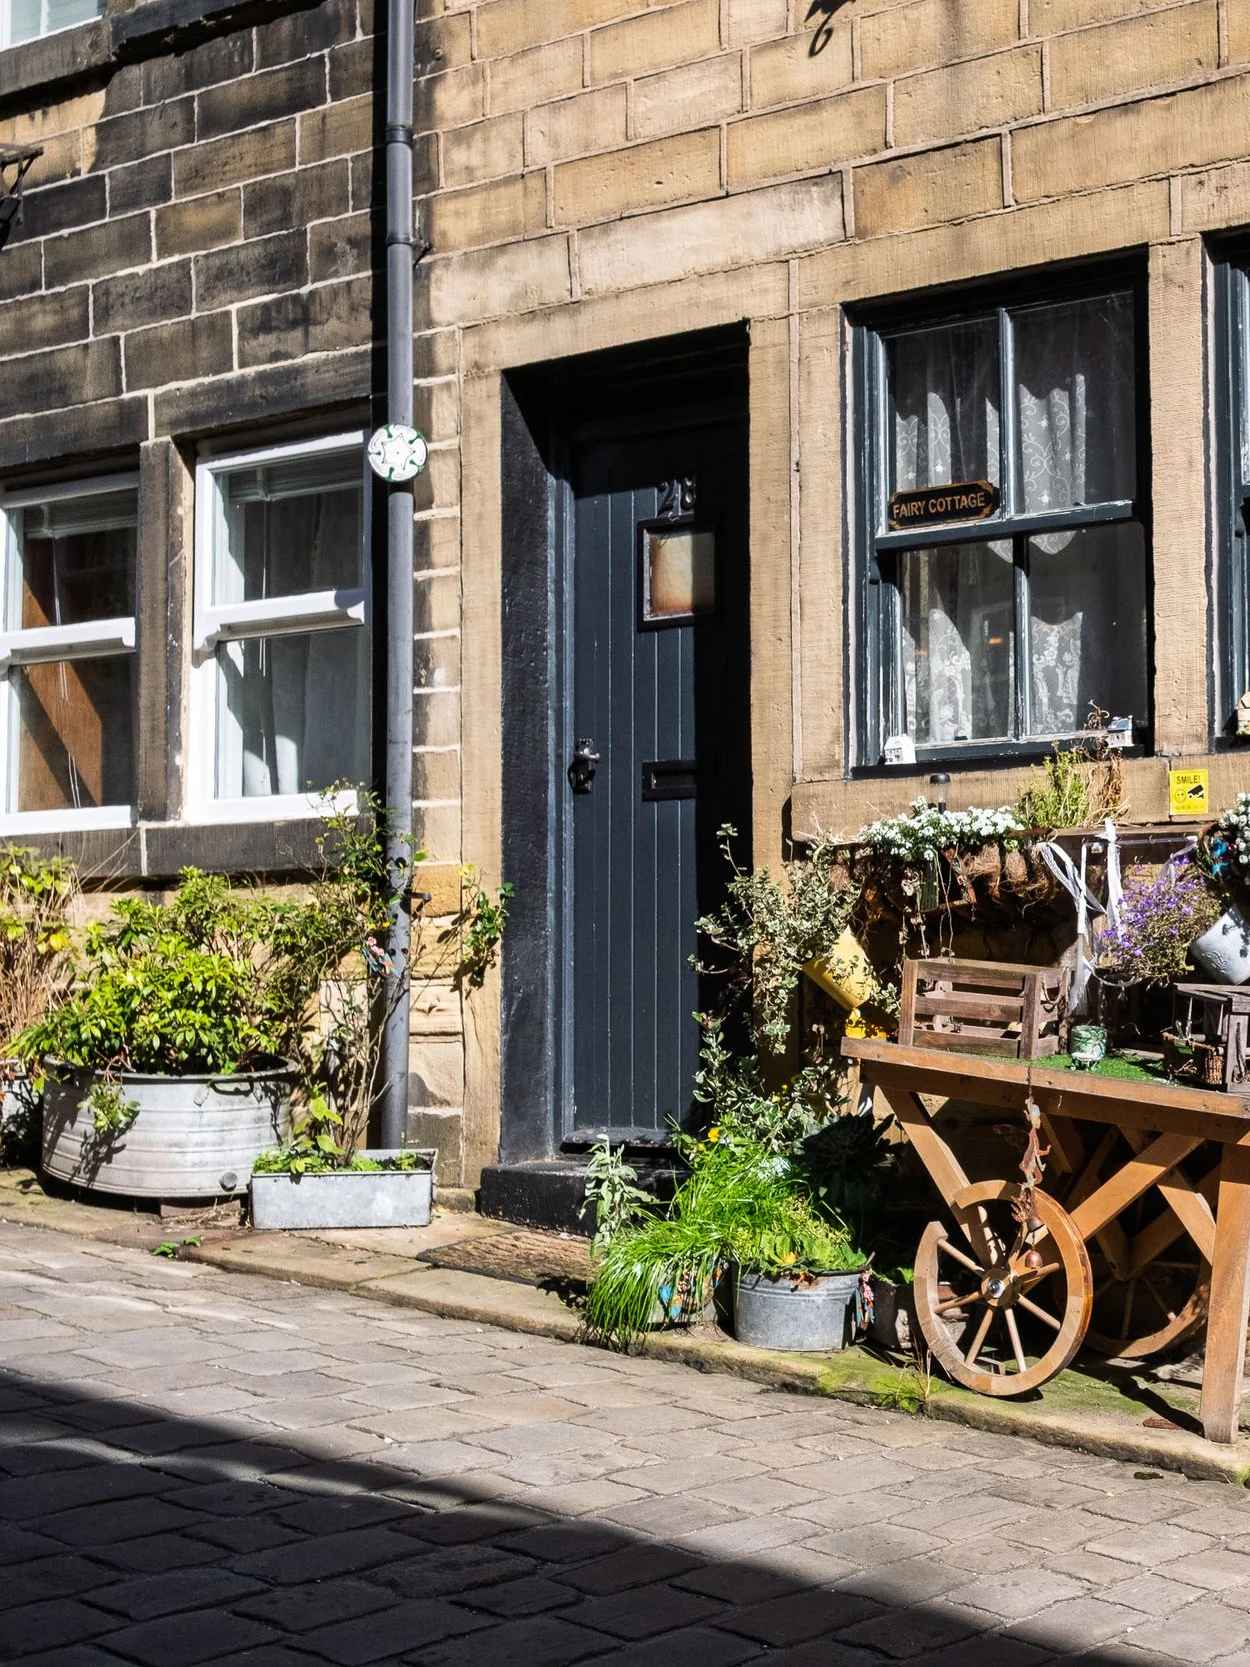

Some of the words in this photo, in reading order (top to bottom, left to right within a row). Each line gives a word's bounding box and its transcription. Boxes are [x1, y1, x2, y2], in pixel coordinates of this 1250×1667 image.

[658, 474, 697, 517] 28
[893, 500, 926, 518] FAIRY
[928, 492, 986, 514] COTTAGE
